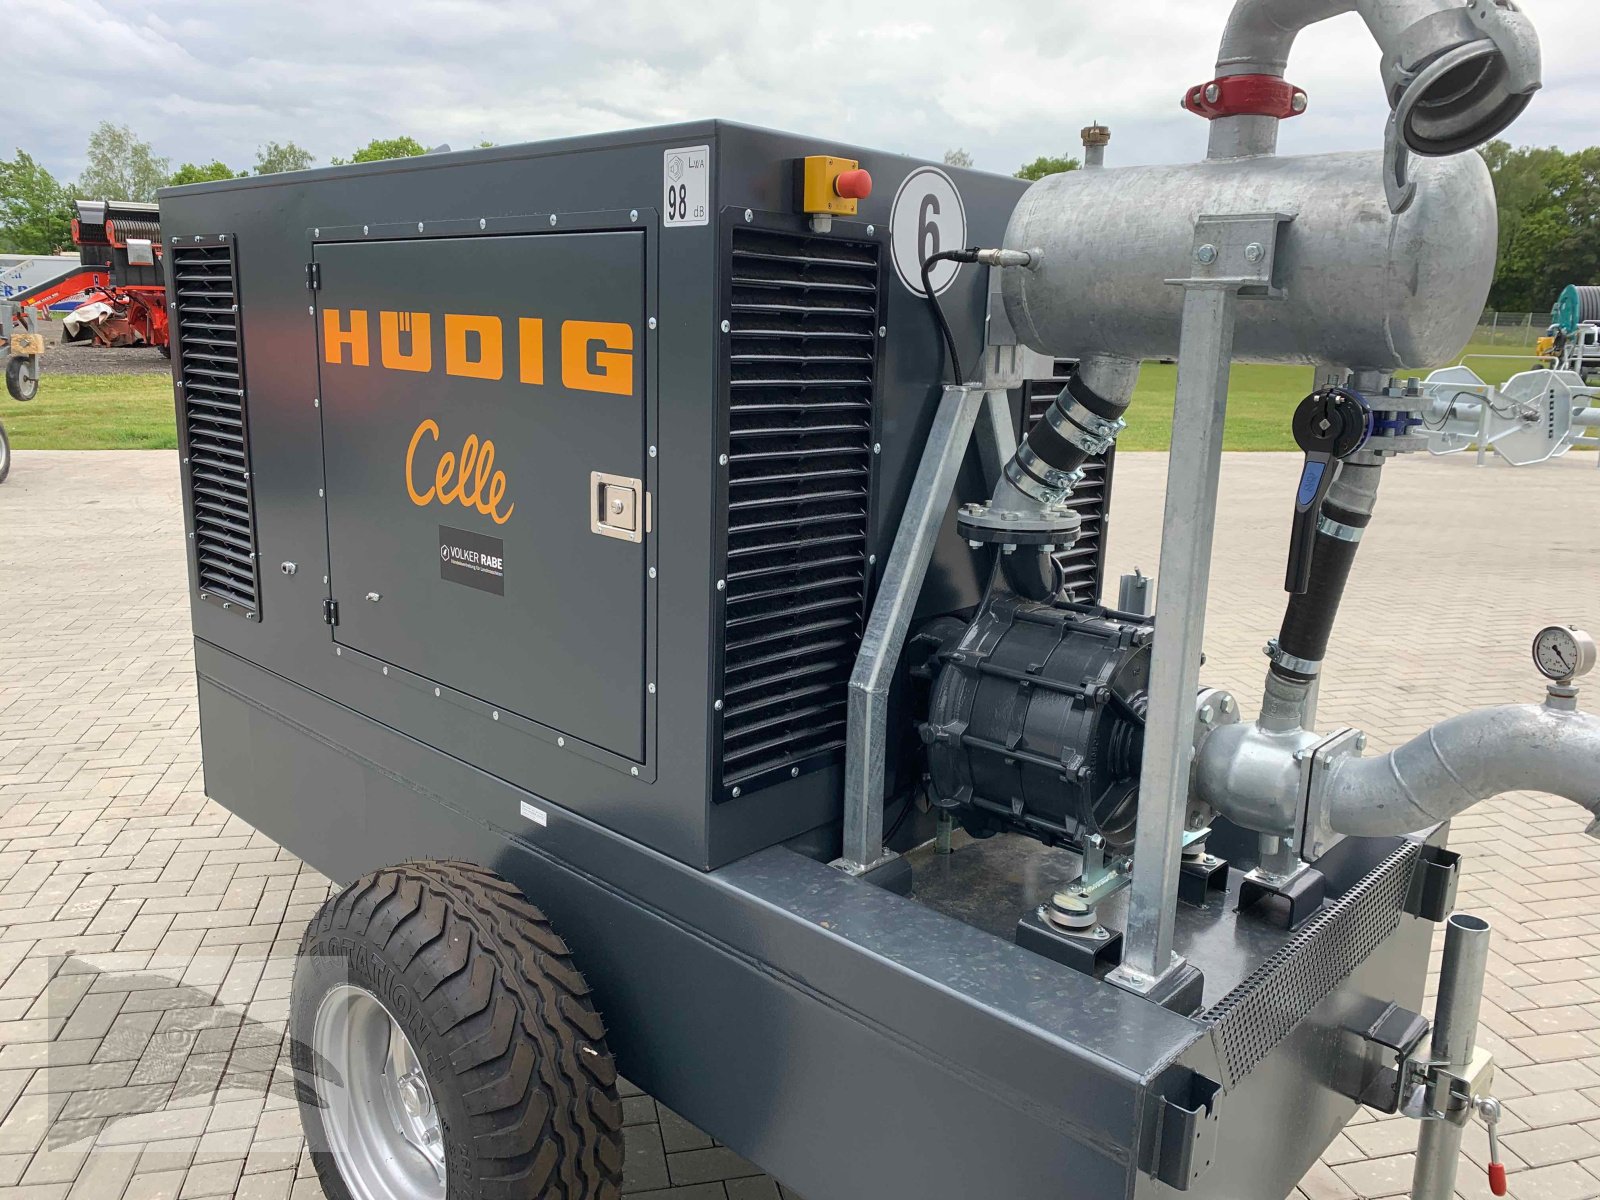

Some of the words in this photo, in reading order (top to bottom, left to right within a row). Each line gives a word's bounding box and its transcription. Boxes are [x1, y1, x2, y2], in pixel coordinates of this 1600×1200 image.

[668, 184, 686, 221] 98
[693, 205, 704, 218] dB
[917, 193, 941, 273] 6
[323, 309, 633, 396] HÜDIG
[405, 418, 515, 524] Celle
[450, 546, 479, 563] VOLKER
[480, 554, 503, 570] RABE
[309, 936, 432, 1050] FLOTATION
